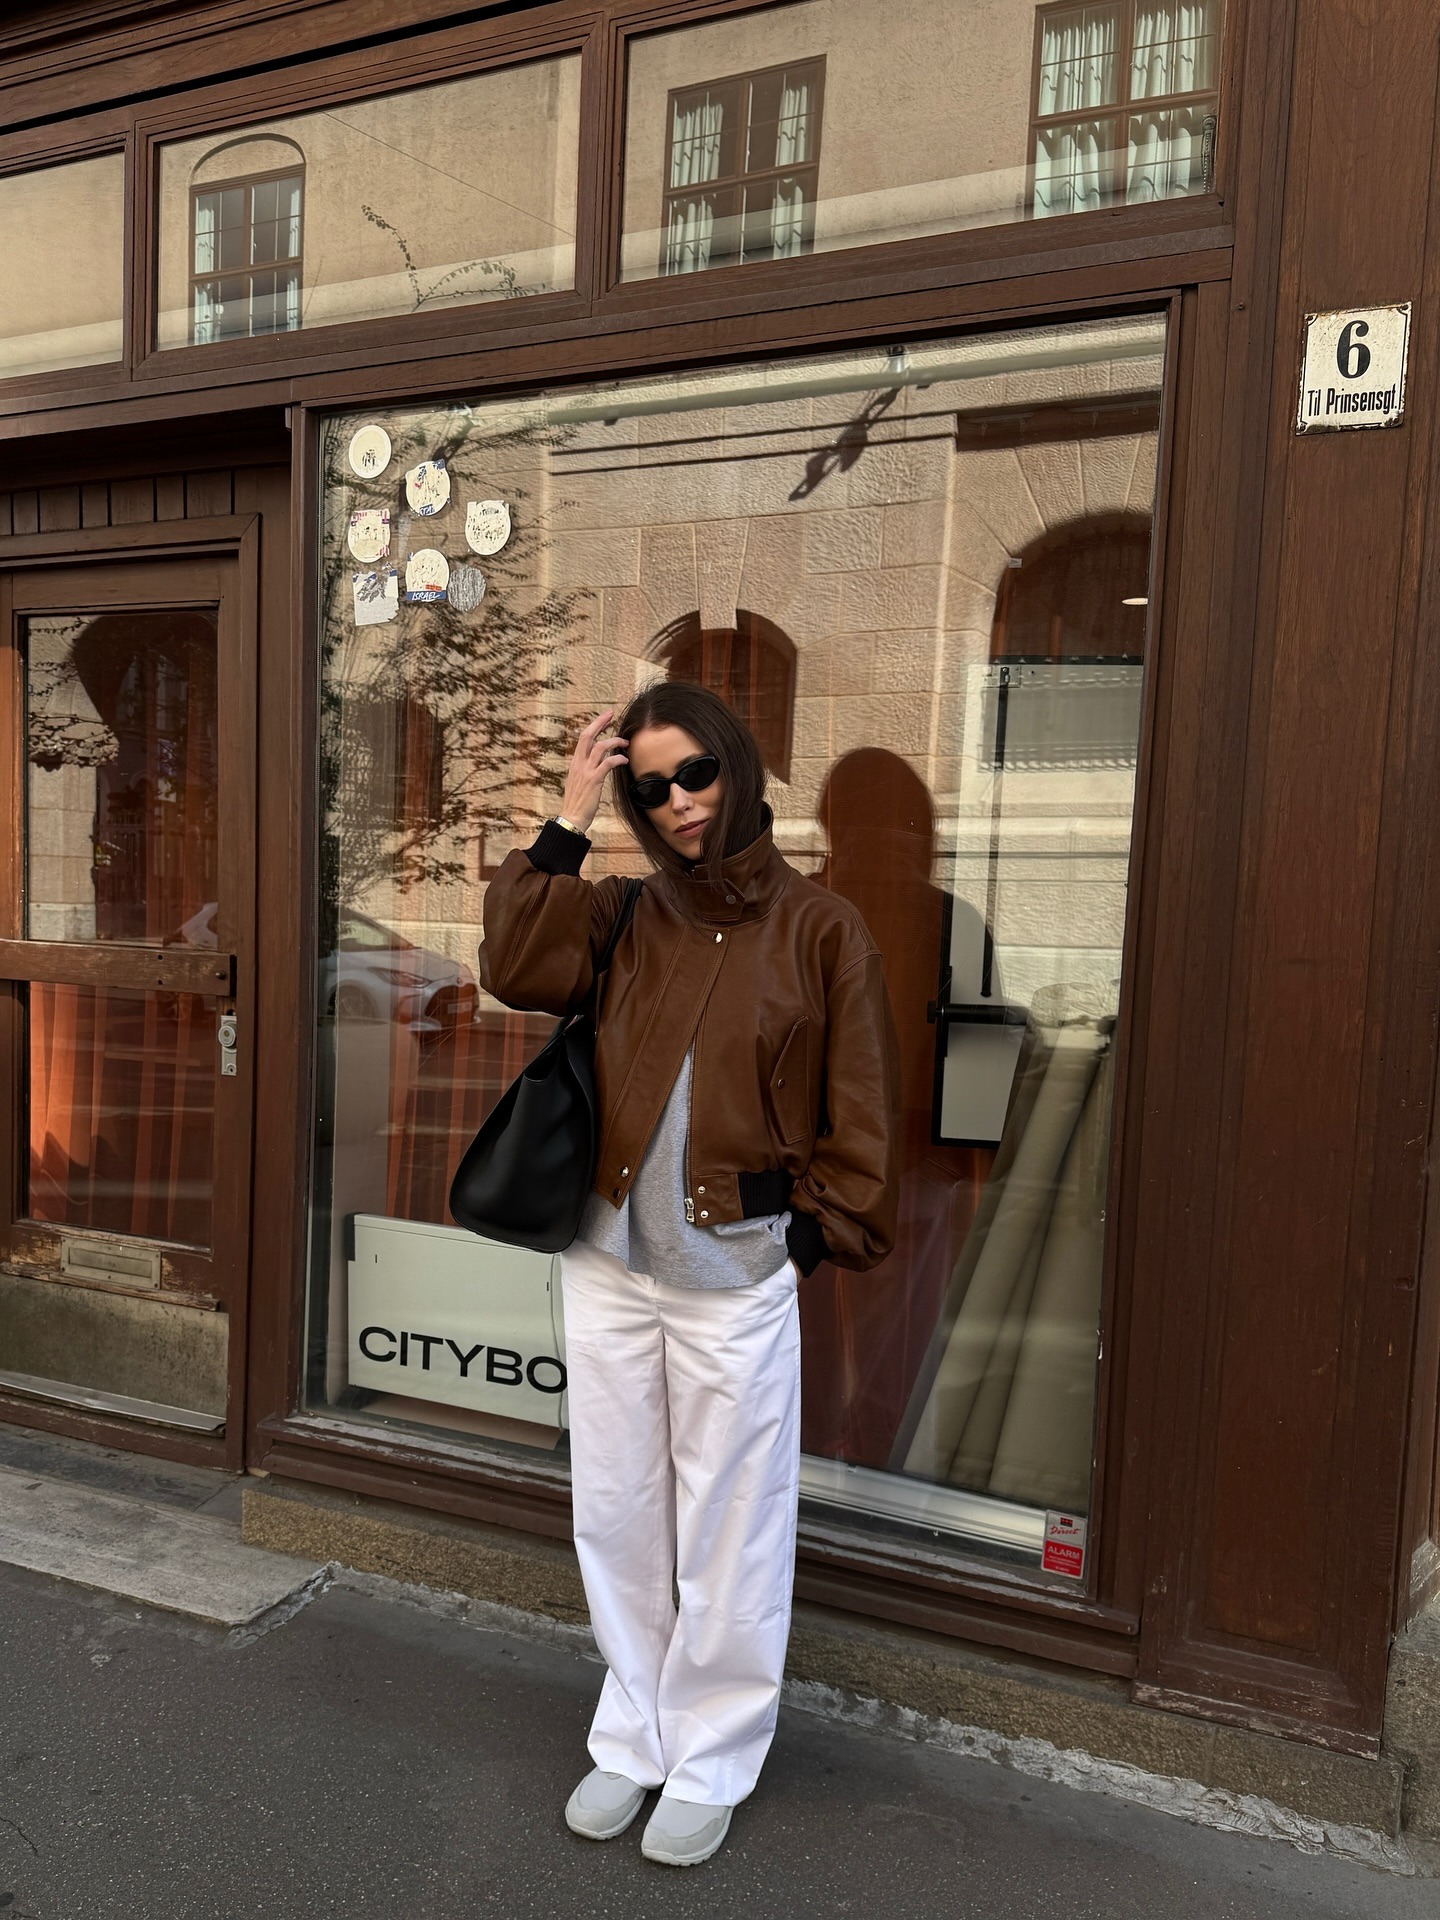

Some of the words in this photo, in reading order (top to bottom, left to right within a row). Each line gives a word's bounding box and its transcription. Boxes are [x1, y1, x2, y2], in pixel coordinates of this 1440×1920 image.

[1337, 320, 1371, 379] 6
[1307, 389, 1321, 416] Til
[1326, 383, 1397, 415] Prinsensgt.
[1047, 1545, 1080, 1560] ALARM
